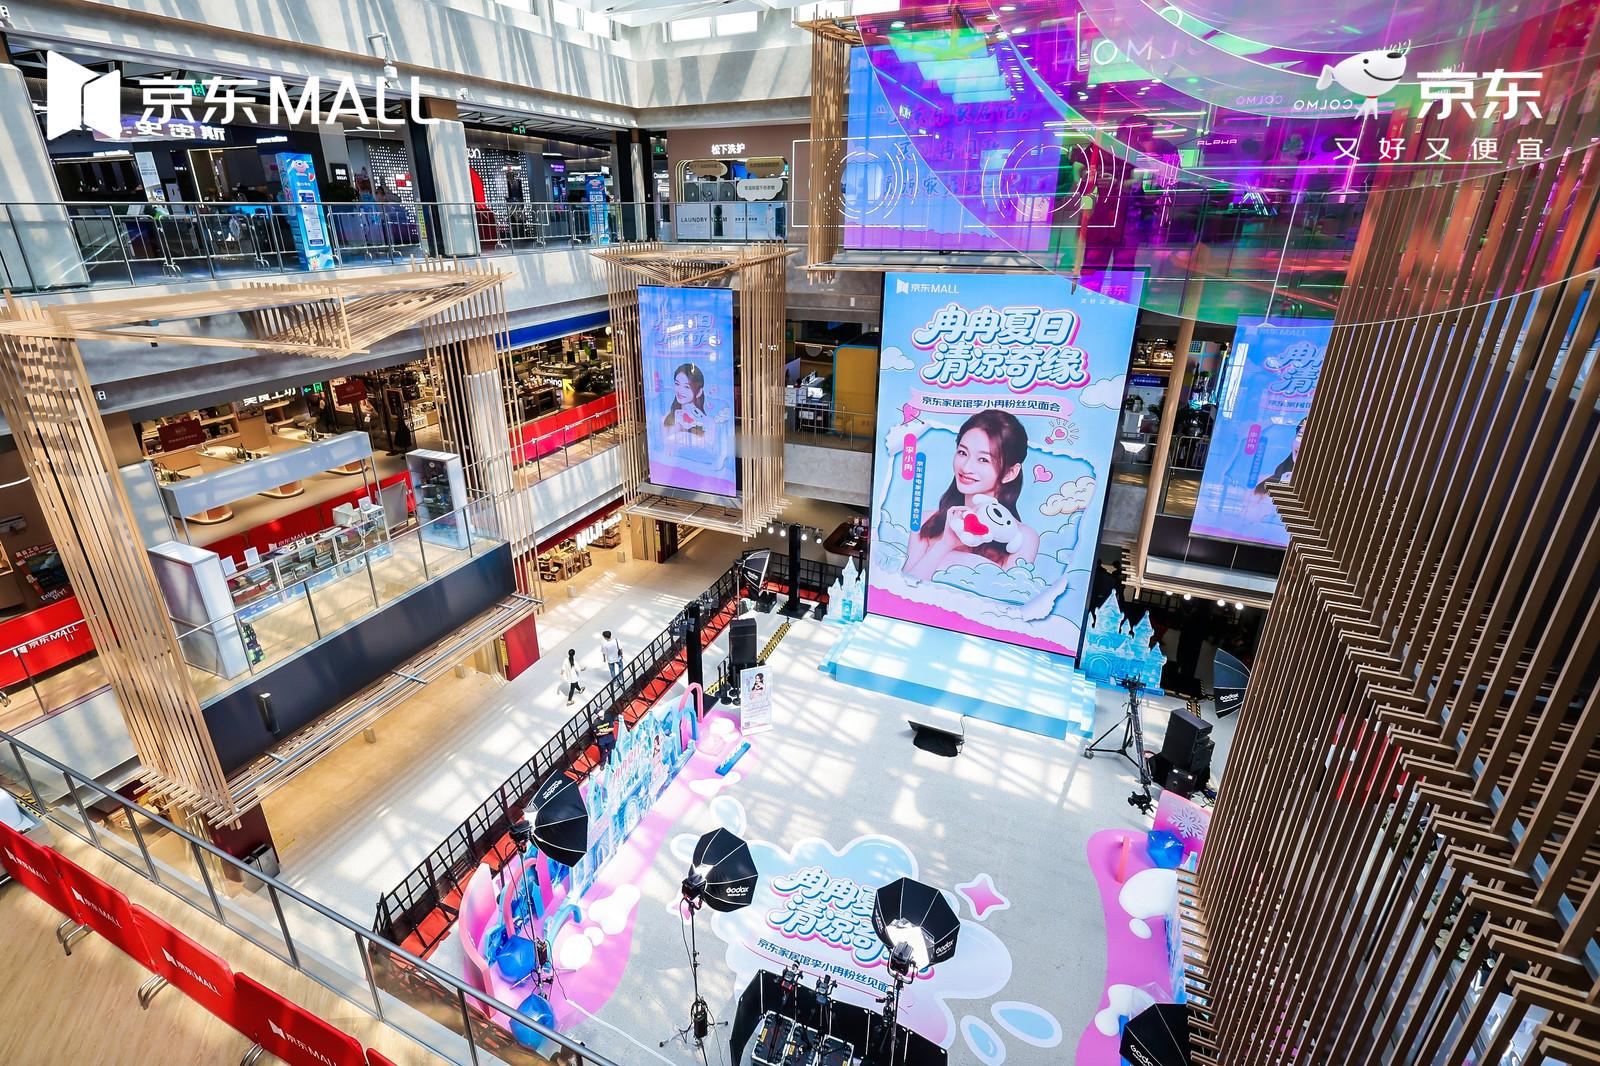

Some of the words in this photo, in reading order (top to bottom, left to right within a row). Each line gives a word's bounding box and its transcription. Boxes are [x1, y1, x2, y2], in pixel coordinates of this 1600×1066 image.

[711, 142, 746, 156] 松下洗护
[1196, 138, 1238, 146] ALPHA
[911, 283, 960, 294] 京东MALL
[914, 303, 1075, 347] 冉冉夏日
[923, 342, 1085, 390] 清凉奇缘
[1270, 367, 1318, 394] 清
[921, 395, 1061, 412] 京东家居馆李小冉粉丝见面会
[576, 520, 604, 551] MUJI
[28, 625, 80, 650] 京东MALL
[725, 885, 750, 894] Godox
[773, 868, 879, 917] 冉冉夏
[769, 894, 890, 963] 清凉奇
[935, 939, 955, 954] Godox
[757, 937, 889, 993] 京东家居馆李小冉粉丝见面
[1130, 1044, 1154, 1066] Godo
